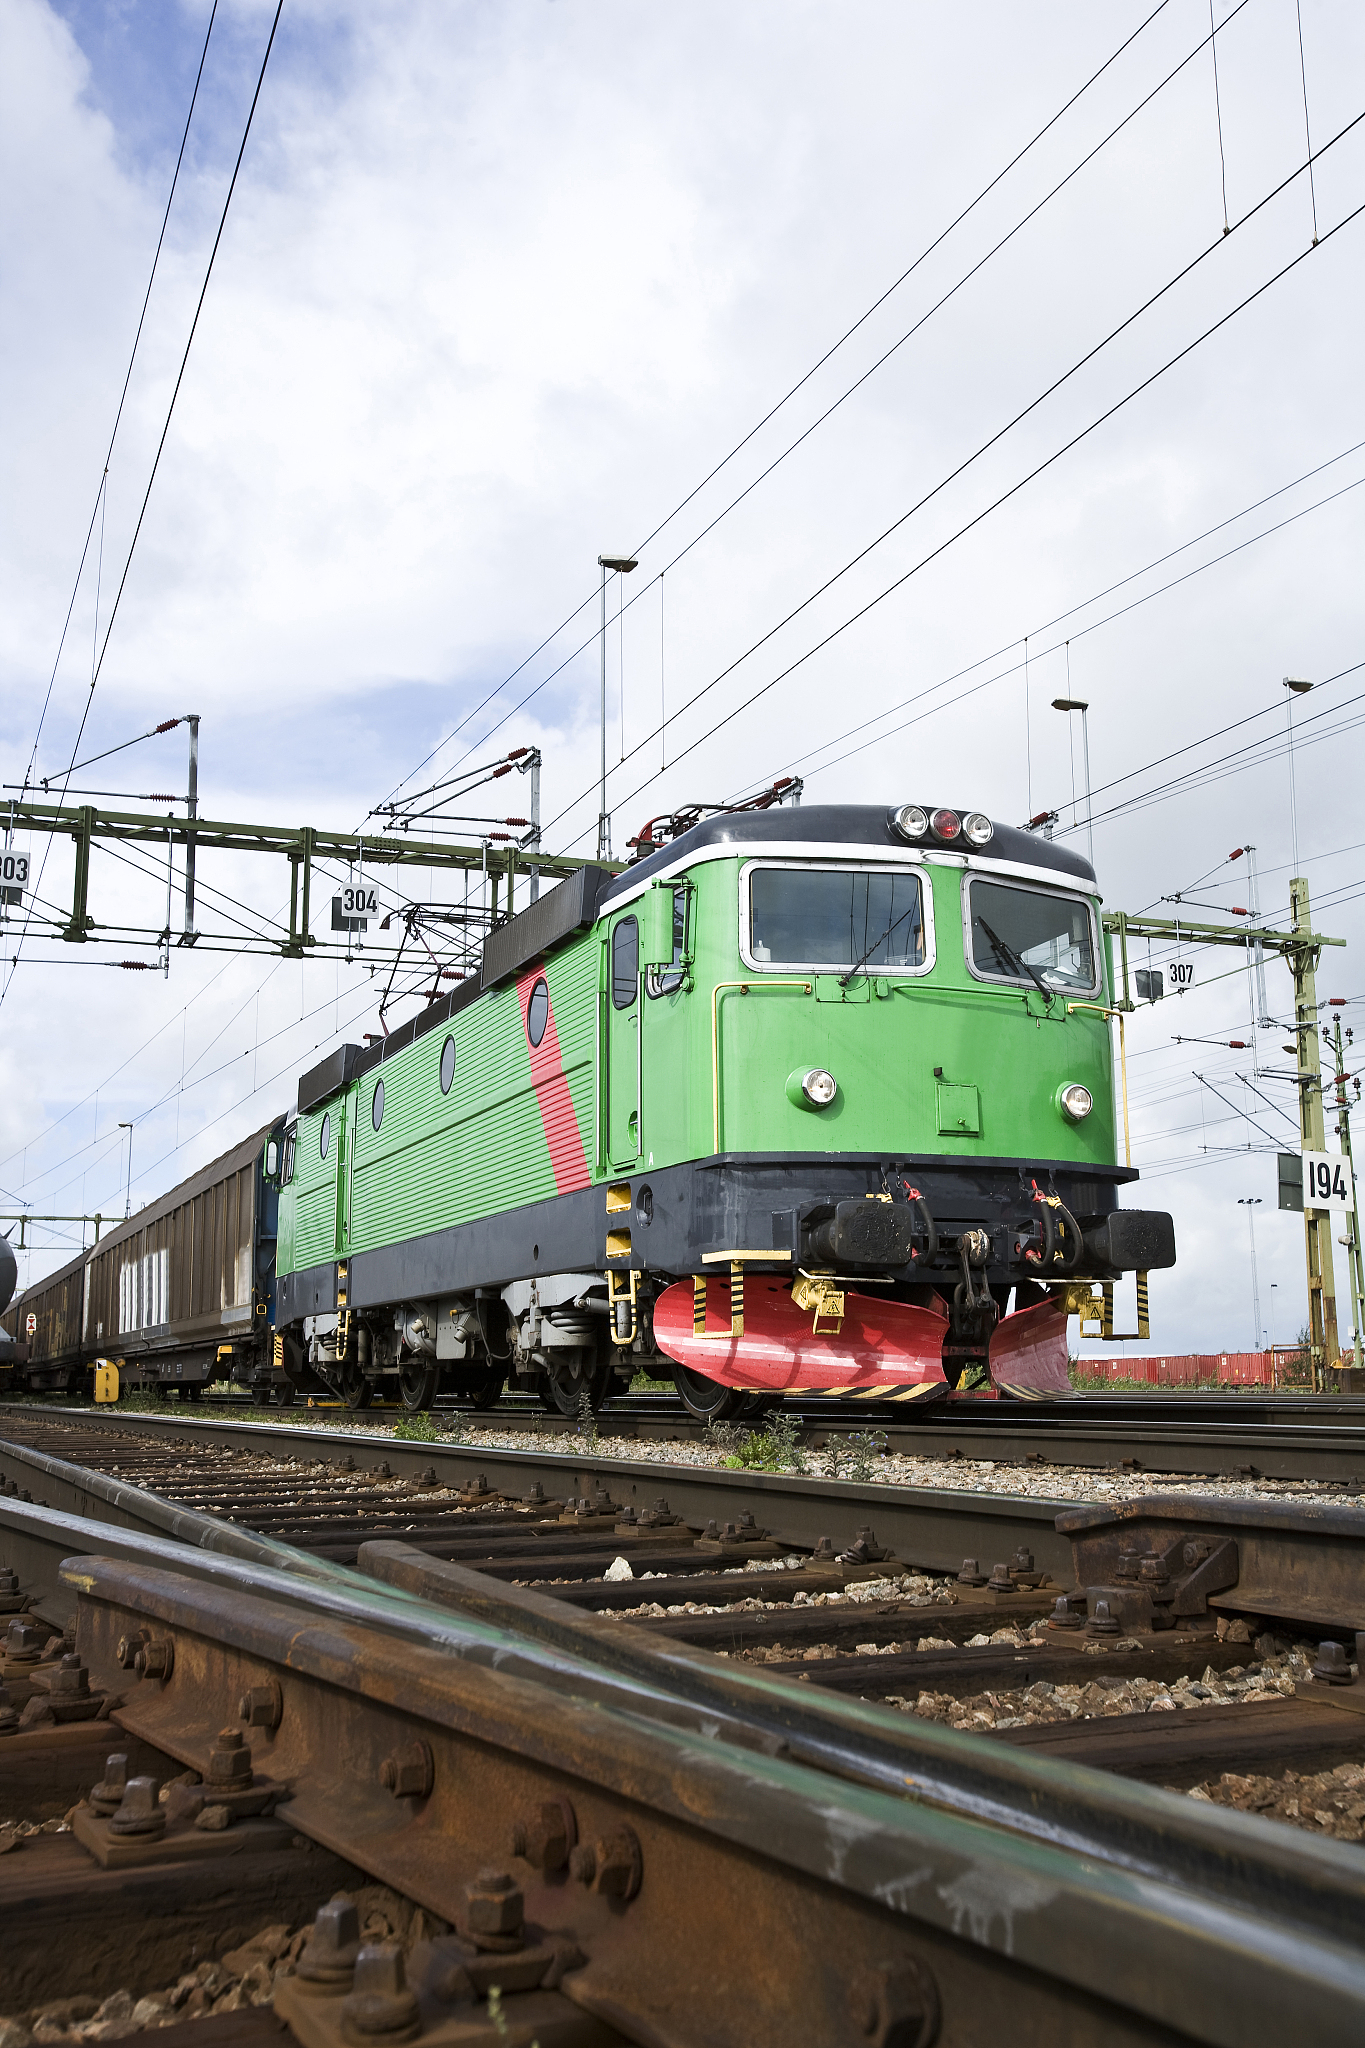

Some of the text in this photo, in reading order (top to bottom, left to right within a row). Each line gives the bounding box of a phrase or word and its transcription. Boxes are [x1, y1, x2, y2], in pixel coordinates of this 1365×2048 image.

[0, 856, 28, 882] 03
[344, 888, 378, 913] 304
[1169, 963, 1193, 983] 307
[648, 1151, 654, 1167] A
[1309, 1161, 1348, 1201] 194
